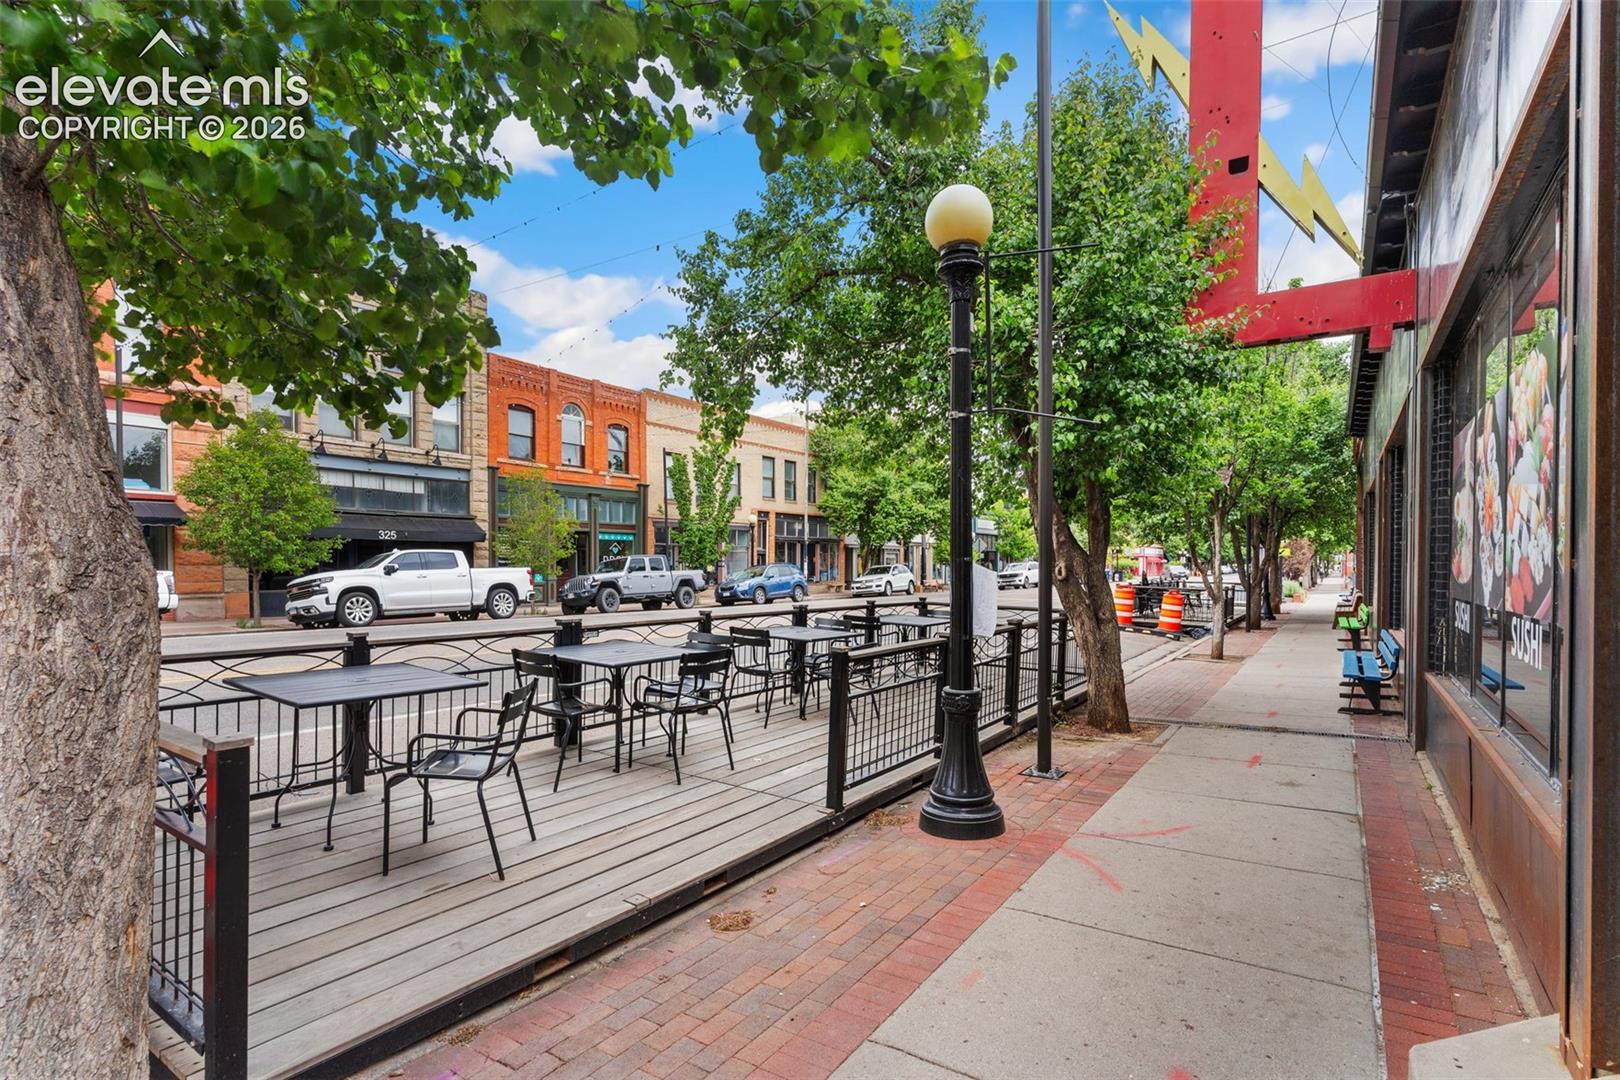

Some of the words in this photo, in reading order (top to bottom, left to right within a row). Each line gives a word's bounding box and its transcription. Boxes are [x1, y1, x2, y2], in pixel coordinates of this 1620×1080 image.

[378, 530, 397, 540] 325
[1455, 600, 1470, 634] SUSHI
[1511, 616, 1542, 671] SUSHI
